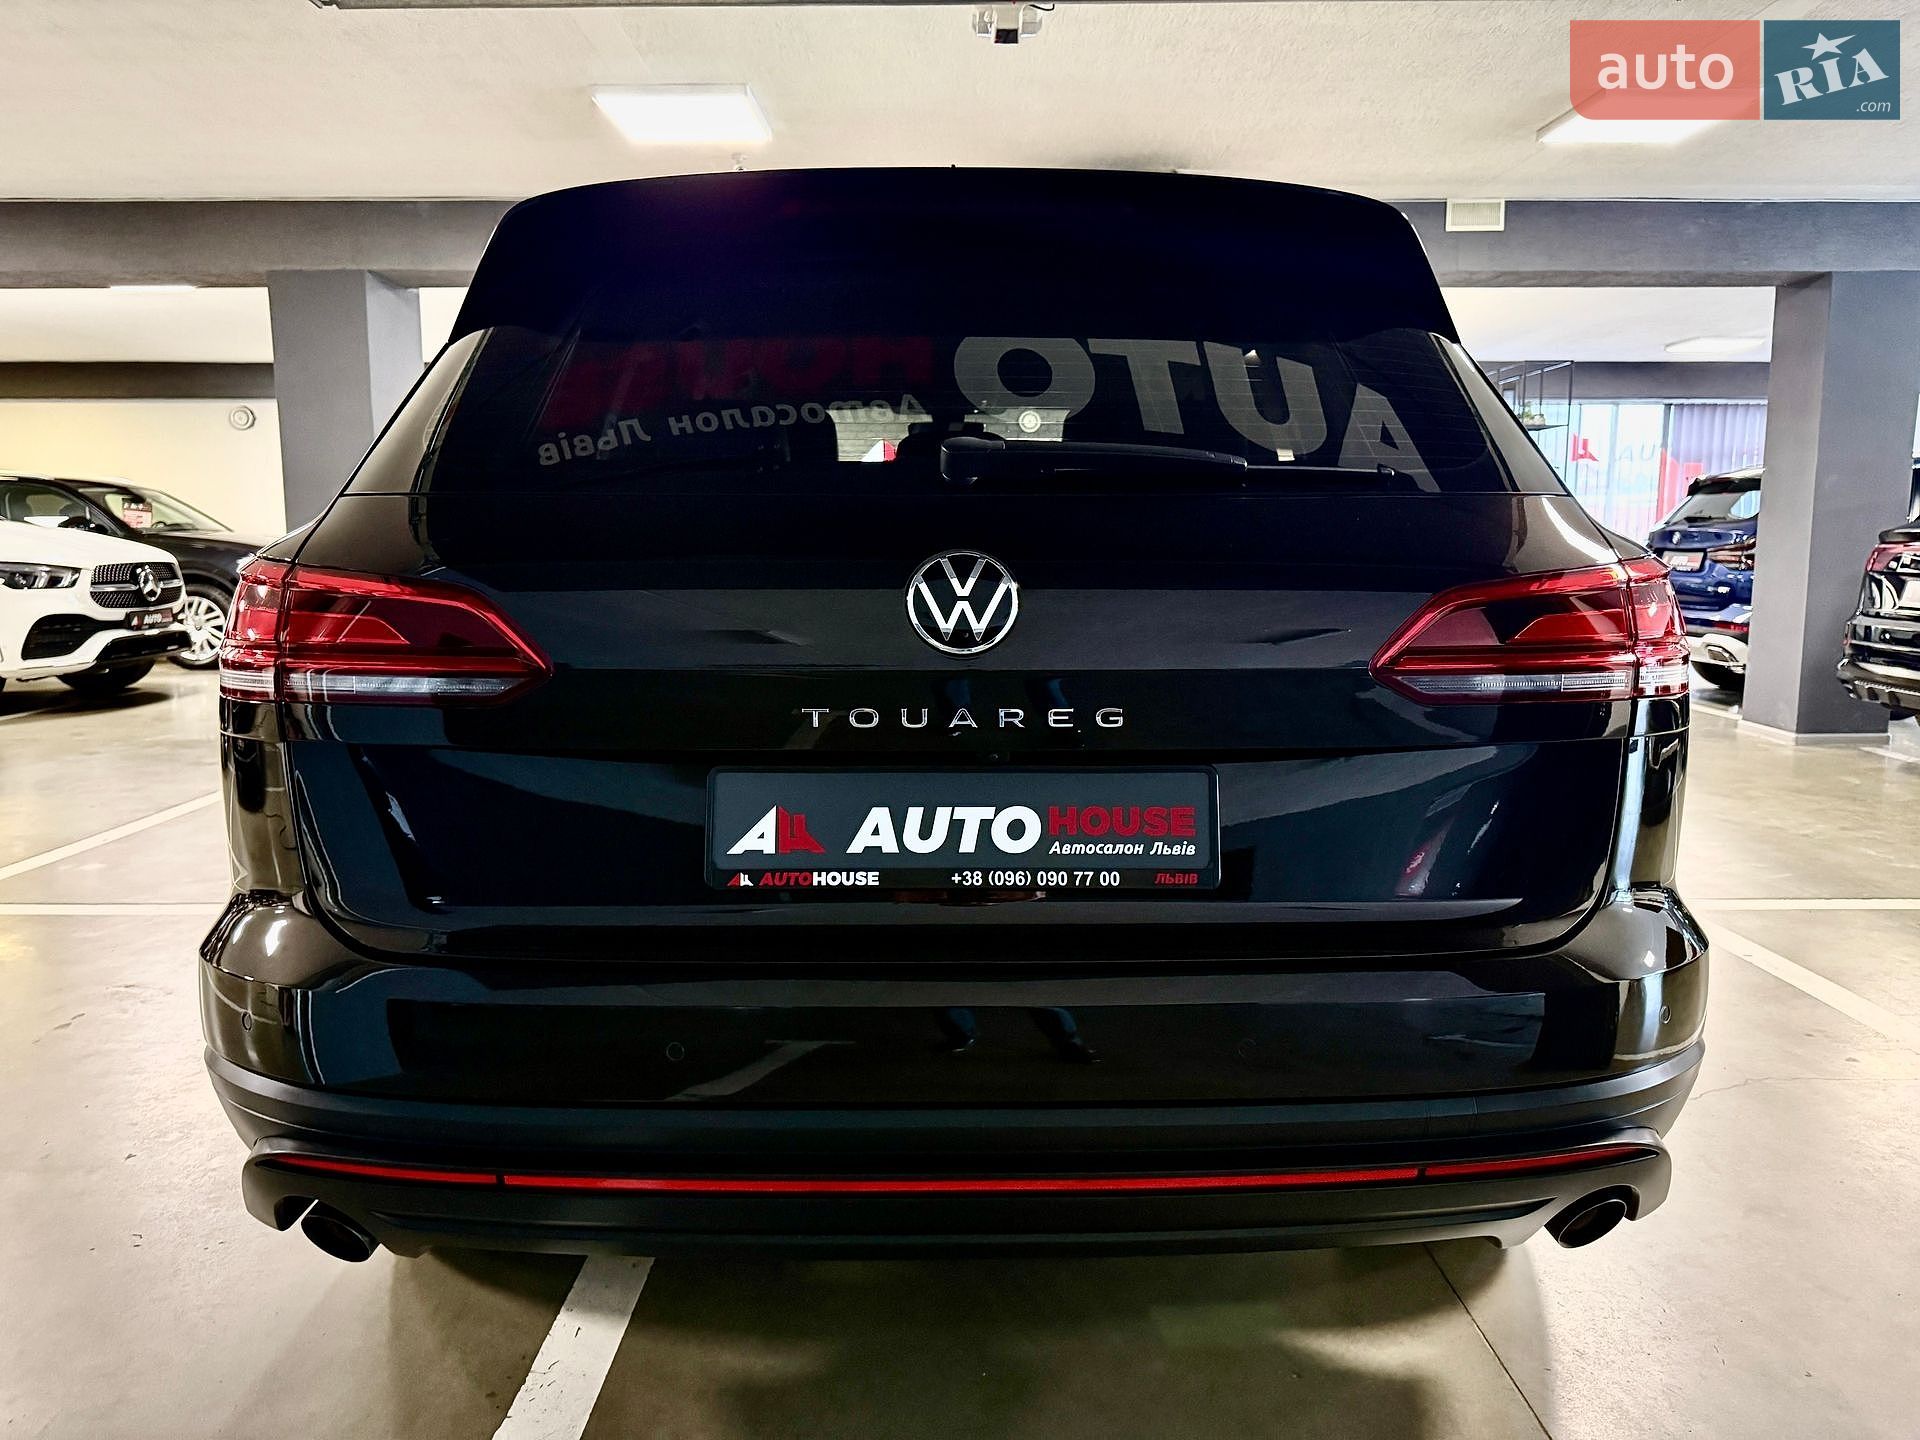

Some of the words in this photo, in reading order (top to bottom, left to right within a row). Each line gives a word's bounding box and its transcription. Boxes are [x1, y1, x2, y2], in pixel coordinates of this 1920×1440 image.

[801, 707, 1124, 729] TOUAREG
[846, 805, 1042, 855] AUTO
[1048, 806, 1197, 837] HOUSE
[1048, 840, 1145, 856] Автосалон
[1149, 840, 1197, 856] Львів
[758, 871, 880, 887] AUTOHOUSE
[951, 870, 983, 887] +38
[988, 869, 1032, 888] (096)
[1036, 870, 1068, 887] 090
[1073, 870, 1095, 887] 77
[1099, 870, 1121, 887] 00
